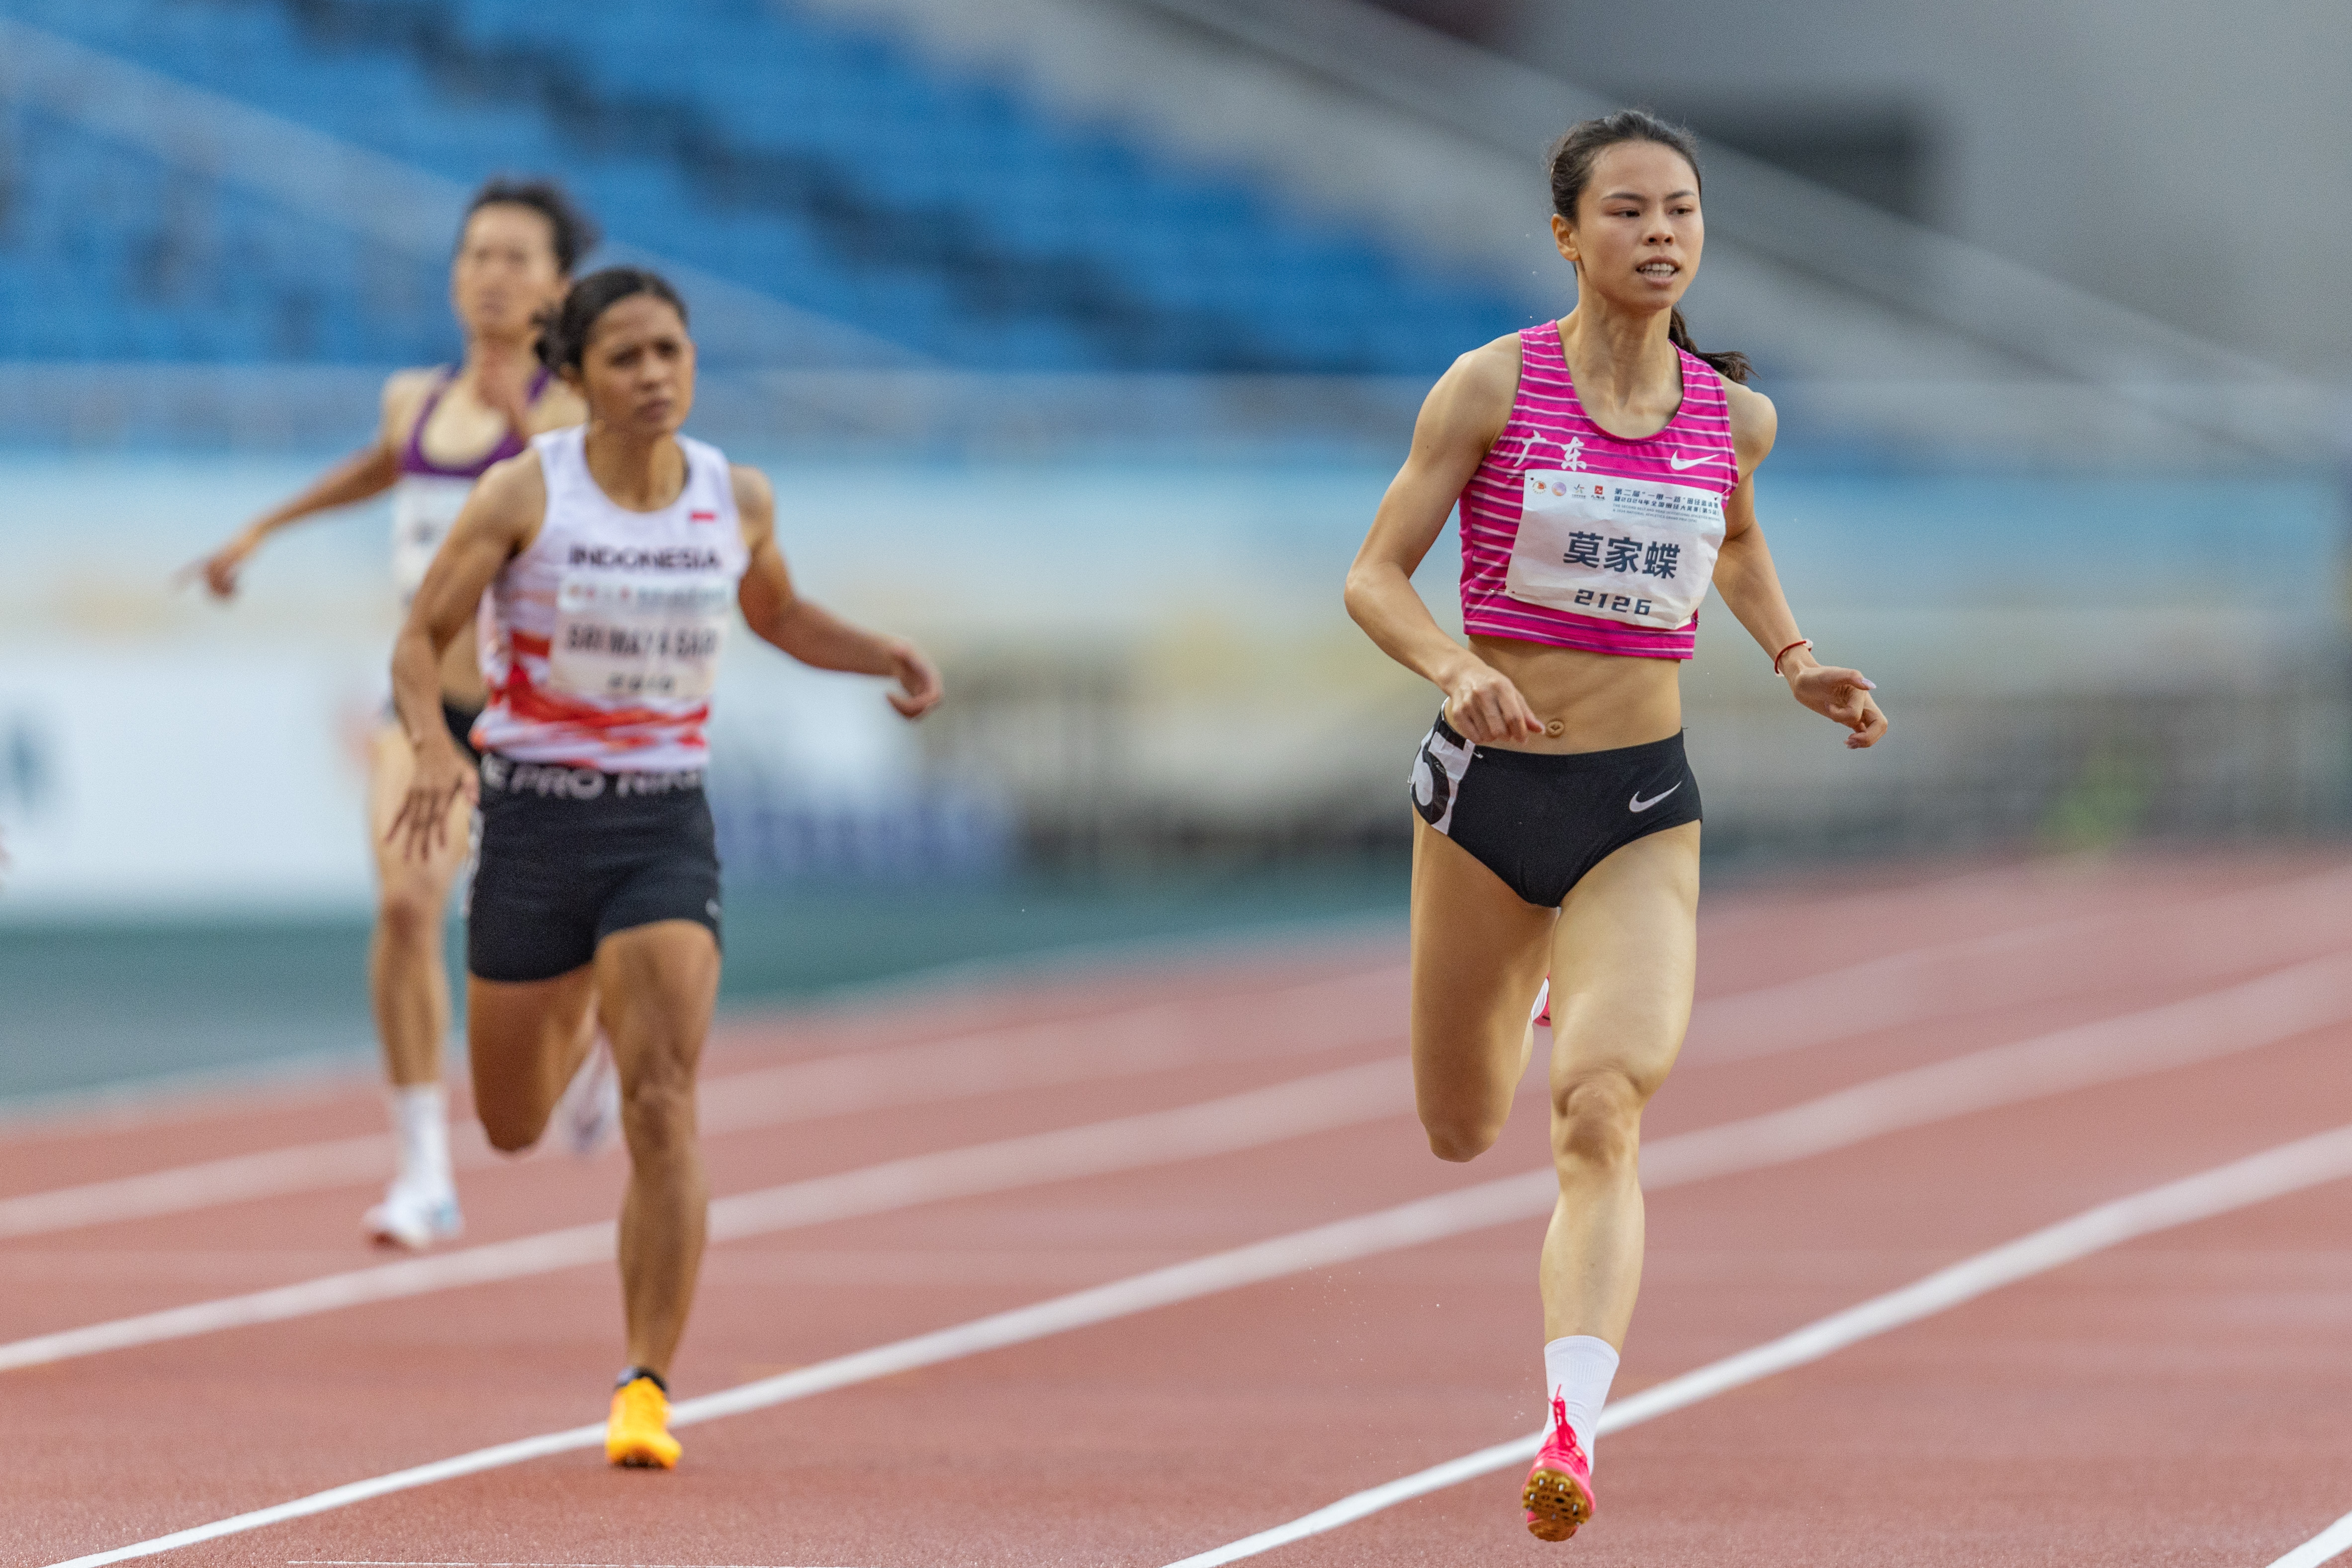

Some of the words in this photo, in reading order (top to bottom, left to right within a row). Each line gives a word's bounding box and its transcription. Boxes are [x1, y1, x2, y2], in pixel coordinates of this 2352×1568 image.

[1513, 430, 1587, 471] 广东
[569, 545, 722, 570] INDONESIA
[1563, 531, 1680, 579] 莫家蝶
[1574, 588, 1652, 616] 2126
